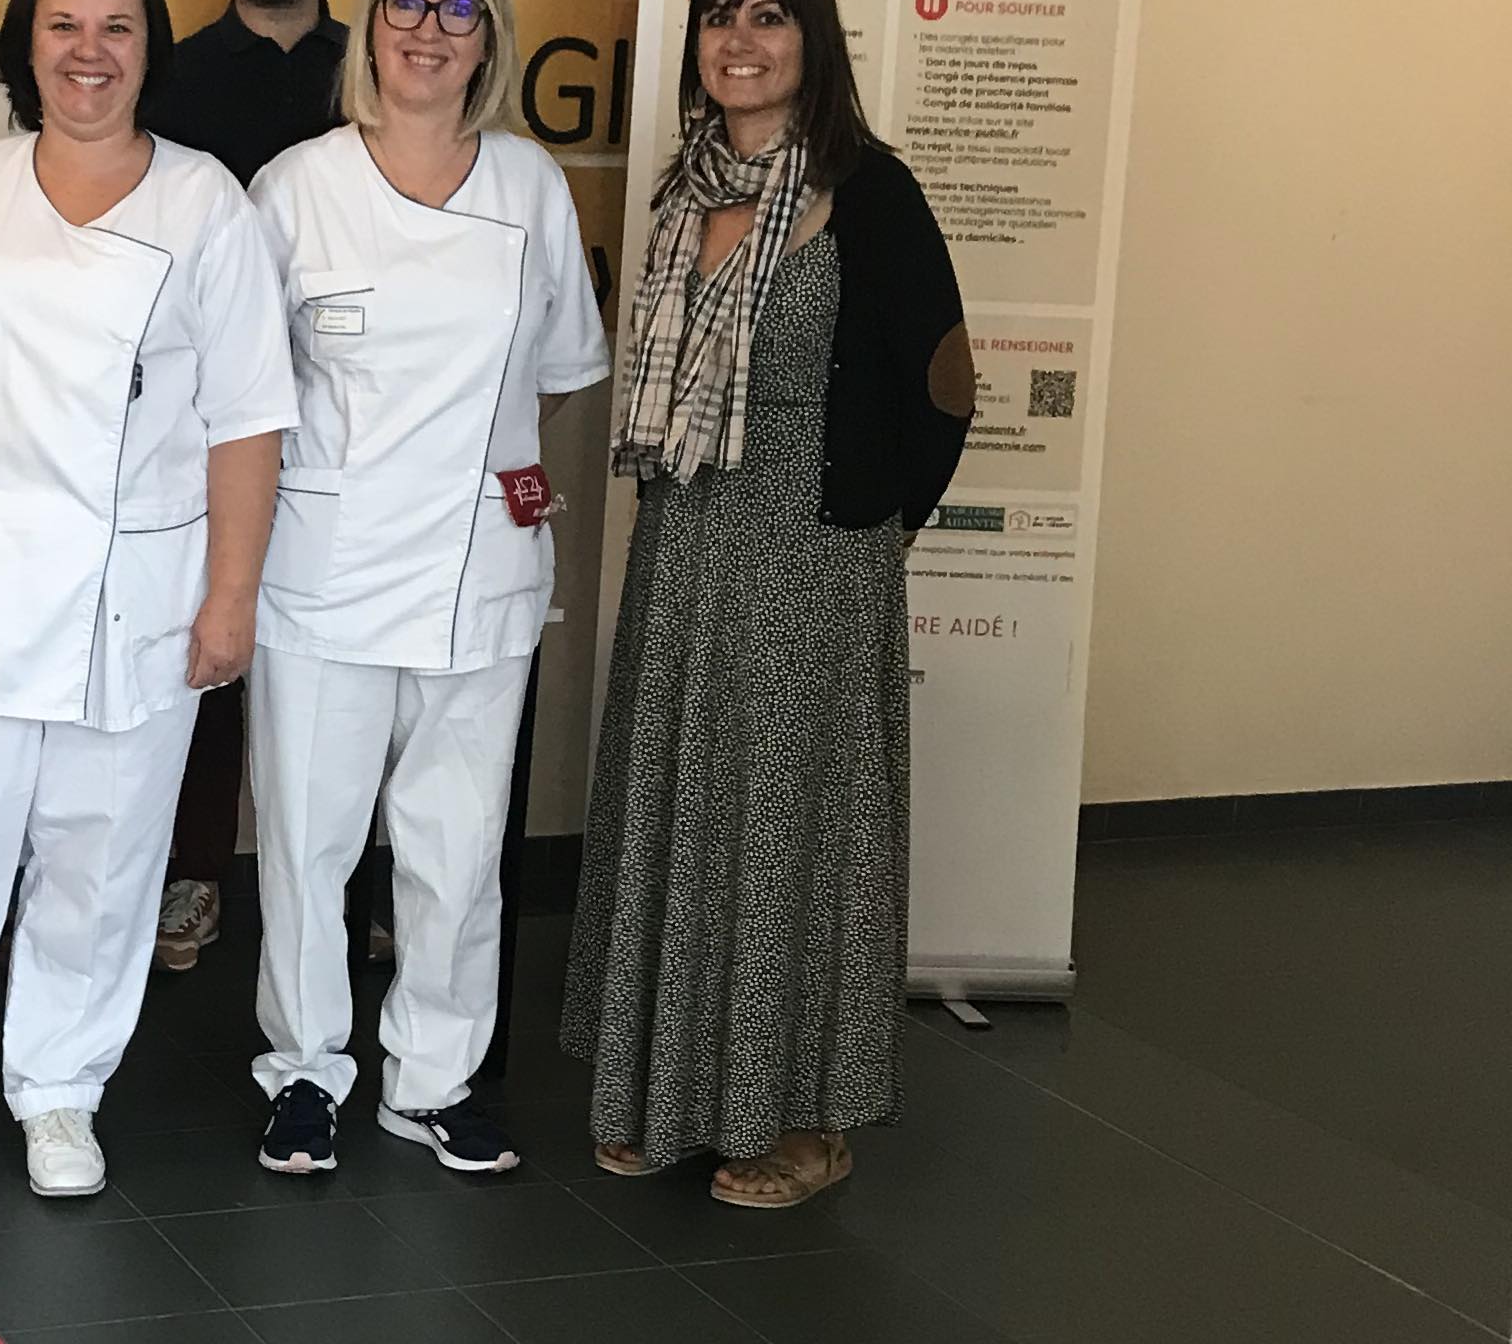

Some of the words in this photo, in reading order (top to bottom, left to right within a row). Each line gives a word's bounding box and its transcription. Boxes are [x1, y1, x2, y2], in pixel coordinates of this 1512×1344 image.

[956, 0, 994, 14] POUR
[998, 1, 1066, 17] SOUFFLER
[926, 57, 946, 67] Don
[949, 58, 961, 67] de
[993, 59, 1006, 69] de
[925, 71, 959, 84] Congé
[961, 72, 974, 81] de
[924, 85, 957, 97] Congé
[959, 87, 973, 95] de
[923, 98, 957, 111] Congé
[959, 99, 972, 108] de
[911, 141, 926, 151] Du
[991, 339, 1074, 354] RENSEIGNER
[908, 615, 940, 635] RE
[949, 614, 1003, 638] AIDÉ
[1013, 619, 1018, 638] !
